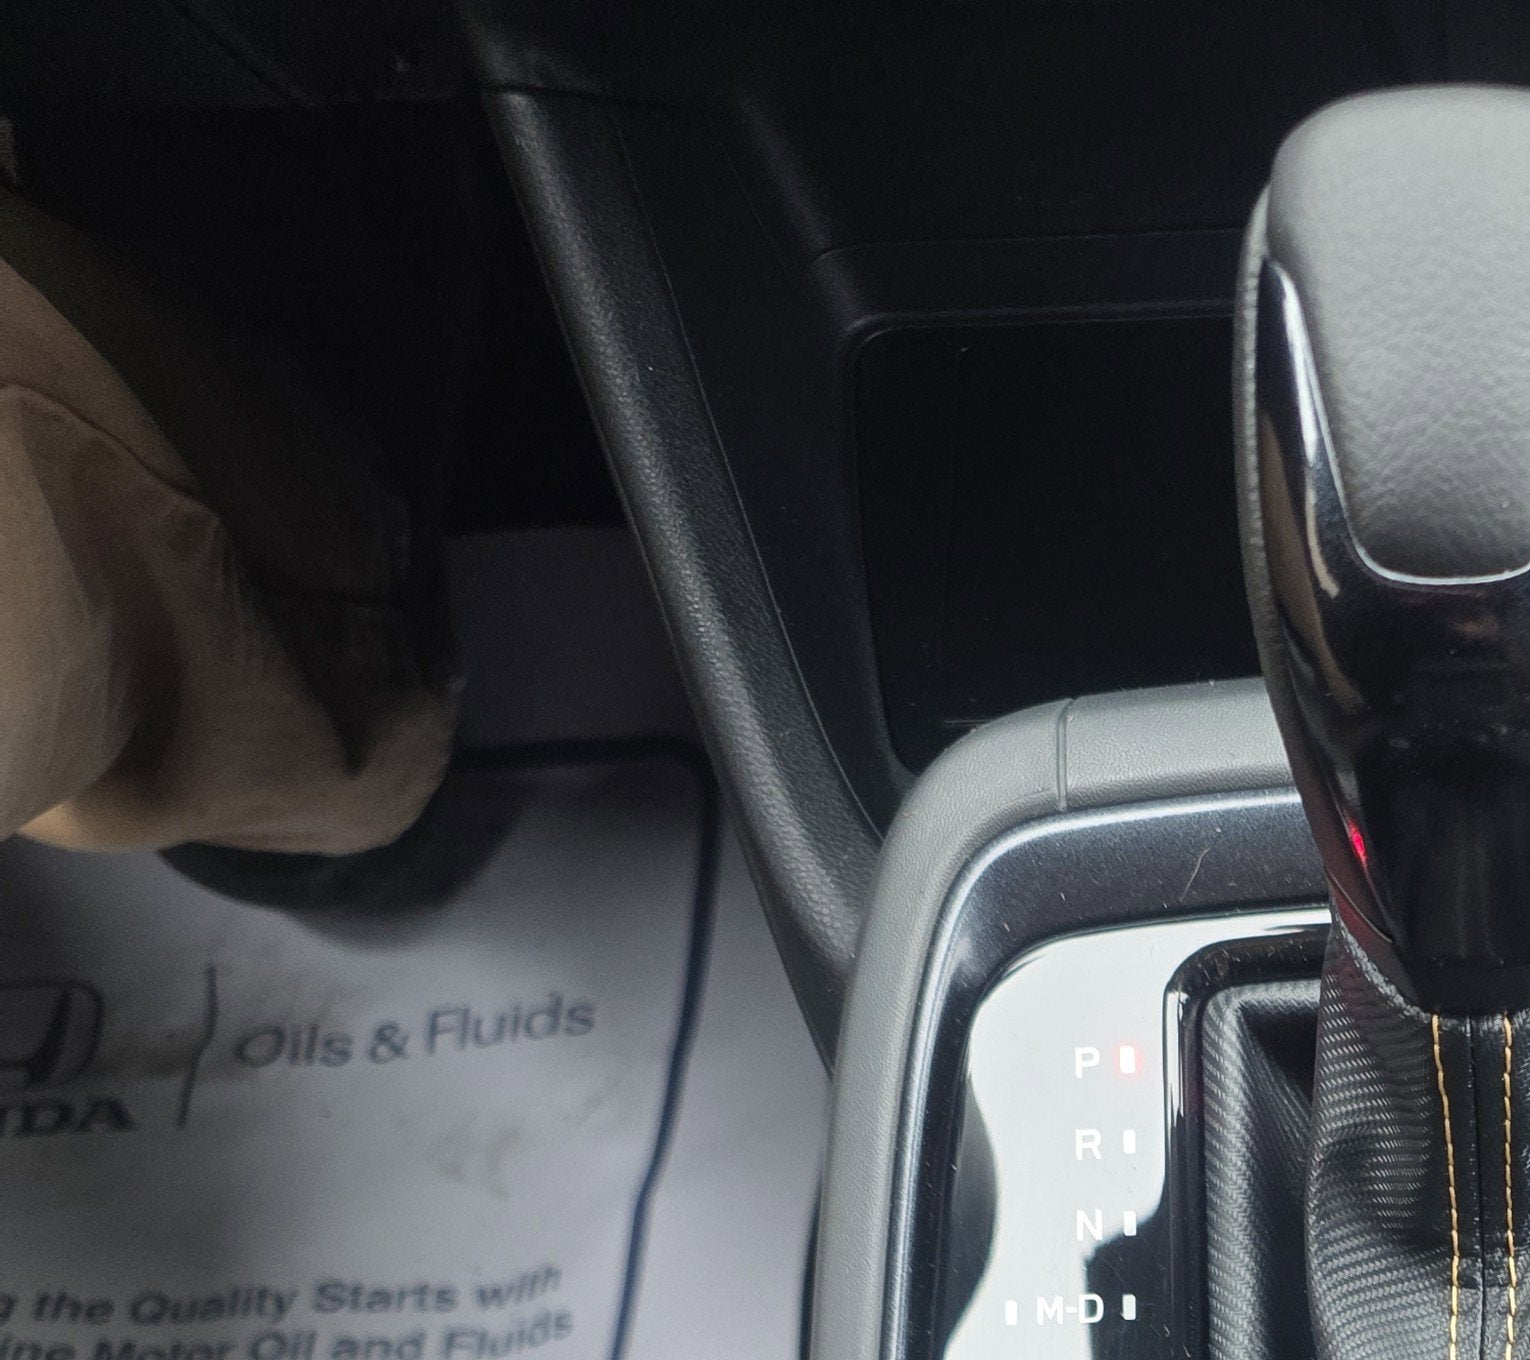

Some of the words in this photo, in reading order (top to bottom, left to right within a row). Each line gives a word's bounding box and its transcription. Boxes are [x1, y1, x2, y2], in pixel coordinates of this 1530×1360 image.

[234, 1024, 355, 1069] Oils
[367, 1022, 409, 1064] &
[423, 992, 599, 1056] Fluids
[1074, 1046, 1101, 1079] P
[1075, 1128, 1102, 1161] R
[1076, 1208, 1103, 1242] N
[32, 1290, 115, 1326] the
[128, 1283, 301, 1328] Quality
[312, 1276, 460, 1315] Starts
[472, 1261, 563, 1312] with
[440, 1306, 576, 1360] Fluids
